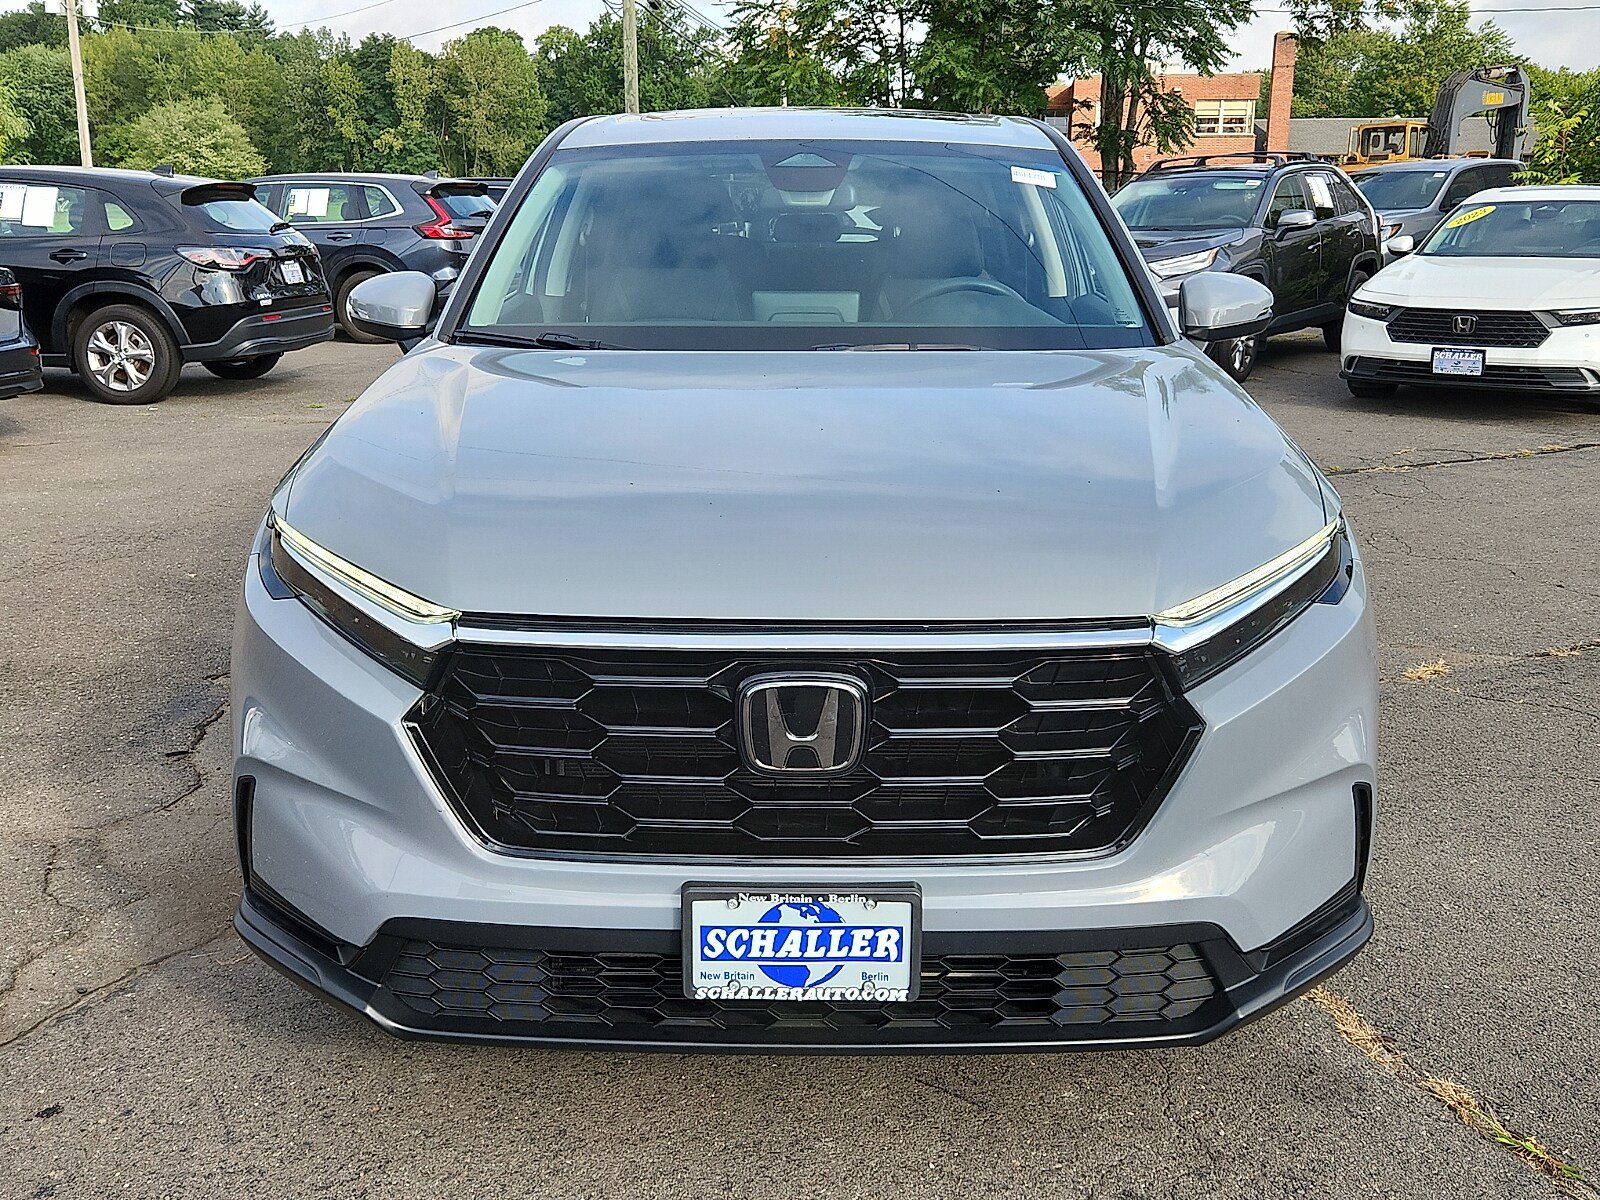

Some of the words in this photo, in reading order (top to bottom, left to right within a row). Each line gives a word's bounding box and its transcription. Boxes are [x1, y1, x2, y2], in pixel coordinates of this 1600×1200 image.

[1434, 351, 1483, 361] SCHALLER
[737, 892, 767, 903] New
[770, 893, 813, 904] Britain
[828, 894, 867, 904] Berlin
[703, 928, 901, 962] SCHALLER
[700, 971, 721, 981] New
[724, 971, 755, 981] Britain
[861, 972, 889, 982] Berlin
[694, 986, 910, 1002] SCHALLERAUTO.COM
